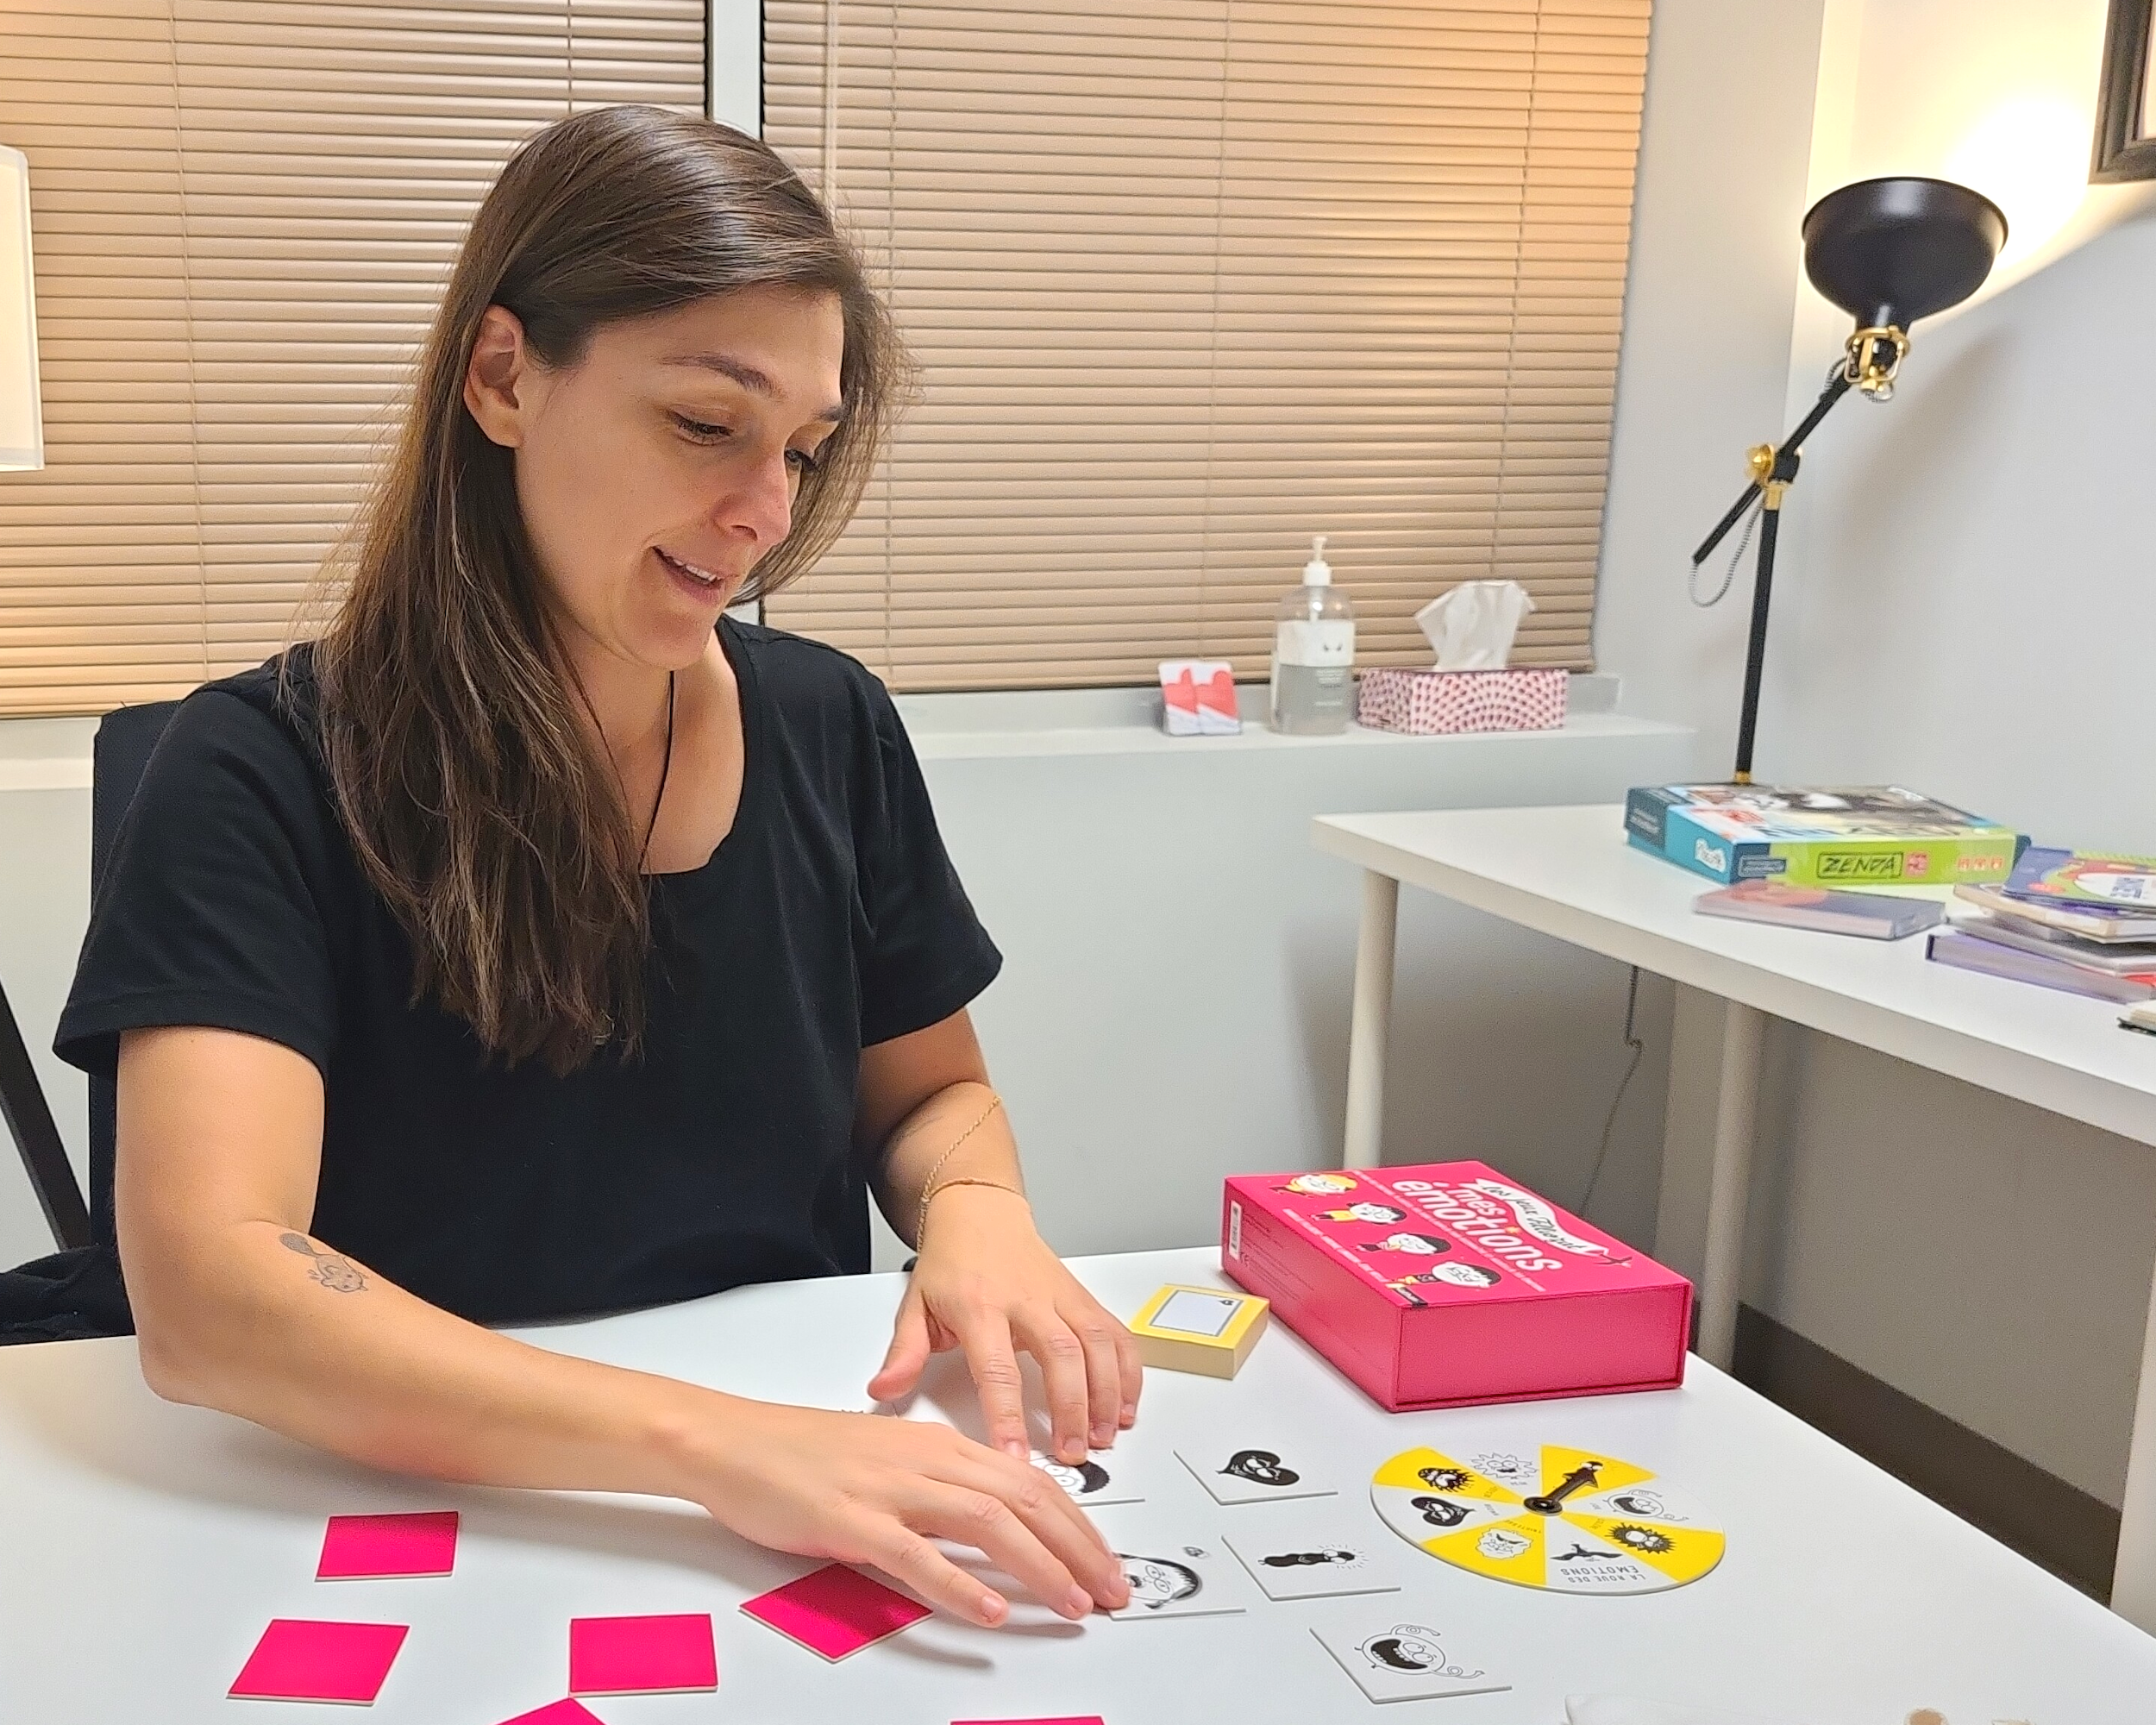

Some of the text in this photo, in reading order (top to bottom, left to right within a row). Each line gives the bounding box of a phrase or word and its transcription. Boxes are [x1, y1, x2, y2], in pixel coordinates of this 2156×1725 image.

[1823, 856, 1895, 873] ZENDA
[1446, 1188, 1507, 1216] mes
[1391, 1180, 1564, 1272] émotions
